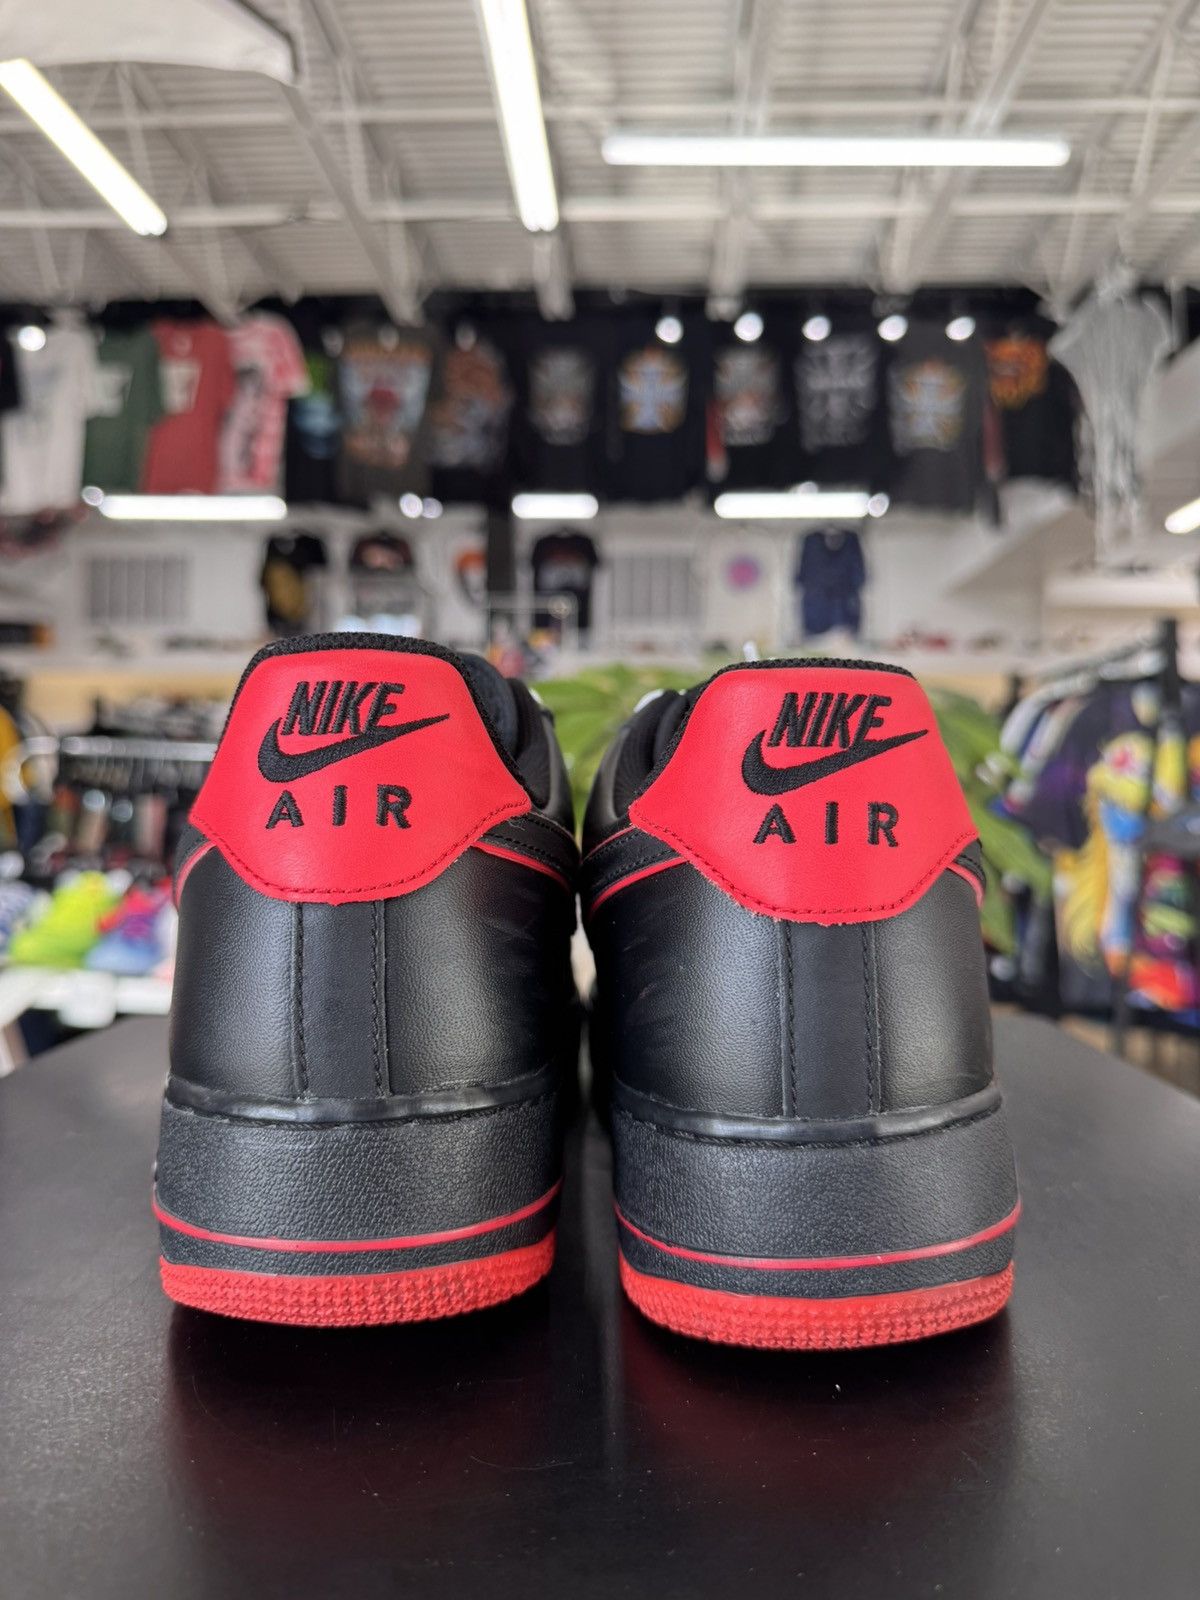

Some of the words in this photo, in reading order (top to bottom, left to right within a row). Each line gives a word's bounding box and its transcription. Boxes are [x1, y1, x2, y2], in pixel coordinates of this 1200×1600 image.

[281, 681, 406, 736] NIKE
[767, 692, 892, 748] NIKE
[265, 784, 412, 829] AIR
[753, 801, 899, 848] AIR
